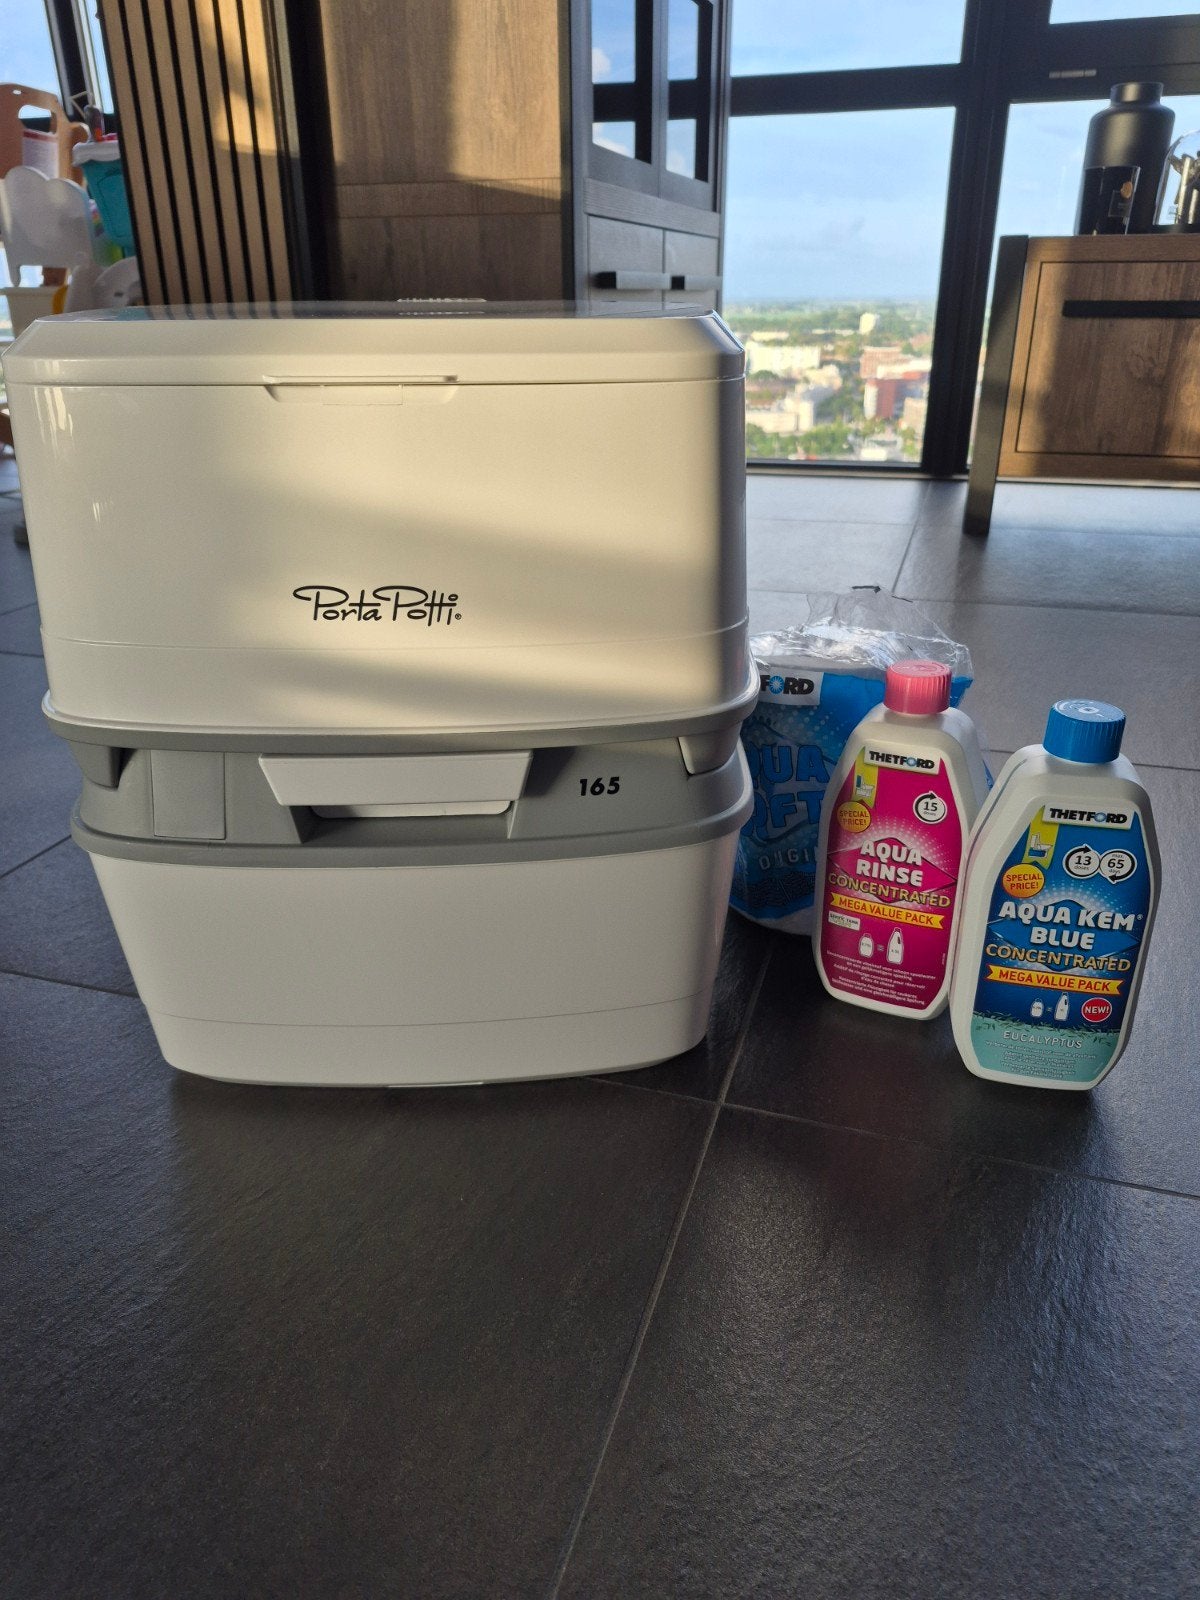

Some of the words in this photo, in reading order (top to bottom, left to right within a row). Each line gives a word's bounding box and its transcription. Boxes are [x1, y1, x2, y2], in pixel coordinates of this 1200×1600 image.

[293, 585, 382, 621] Porta
[869, 750, 935, 769] THETFORD
[580, 776, 620, 796] 165
[839, 810, 869, 818] SPECIAL
[923, 801, 938, 812] 15
[1050, 807, 1128, 824] THETFORD
[842, 818, 867, 826] PRICE!
[860, 840, 922, 865] AQUA
[1075, 855, 1092, 866] 13
[856, 859, 924, 887] RINSE
[1107, 858, 1125, 869] 65
[1006, 874, 1042, 882] SPECIAL
[1010, 882, 1039, 890] PRICE!
[828, 873, 951, 907] CONCENTRATED
[838, 897, 867, 911] MEGA
[869, 904, 902, 920] VALUE
[905, 912, 934, 926] PACK
[998, 901, 1071, 925] AQUA
[1030, 927, 1096, 950] BLUE
[985, 943, 1132, 972] CONCENTRATED
[998, 969, 1034, 984] MEGA
[1036, 973, 1076, 989] VALUE
[1078, 979, 1111, 992] PACK
[1085, 1006, 1109, 1014] NEW!
[1003, 1030, 1083, 1049] EUCALYPTUS
